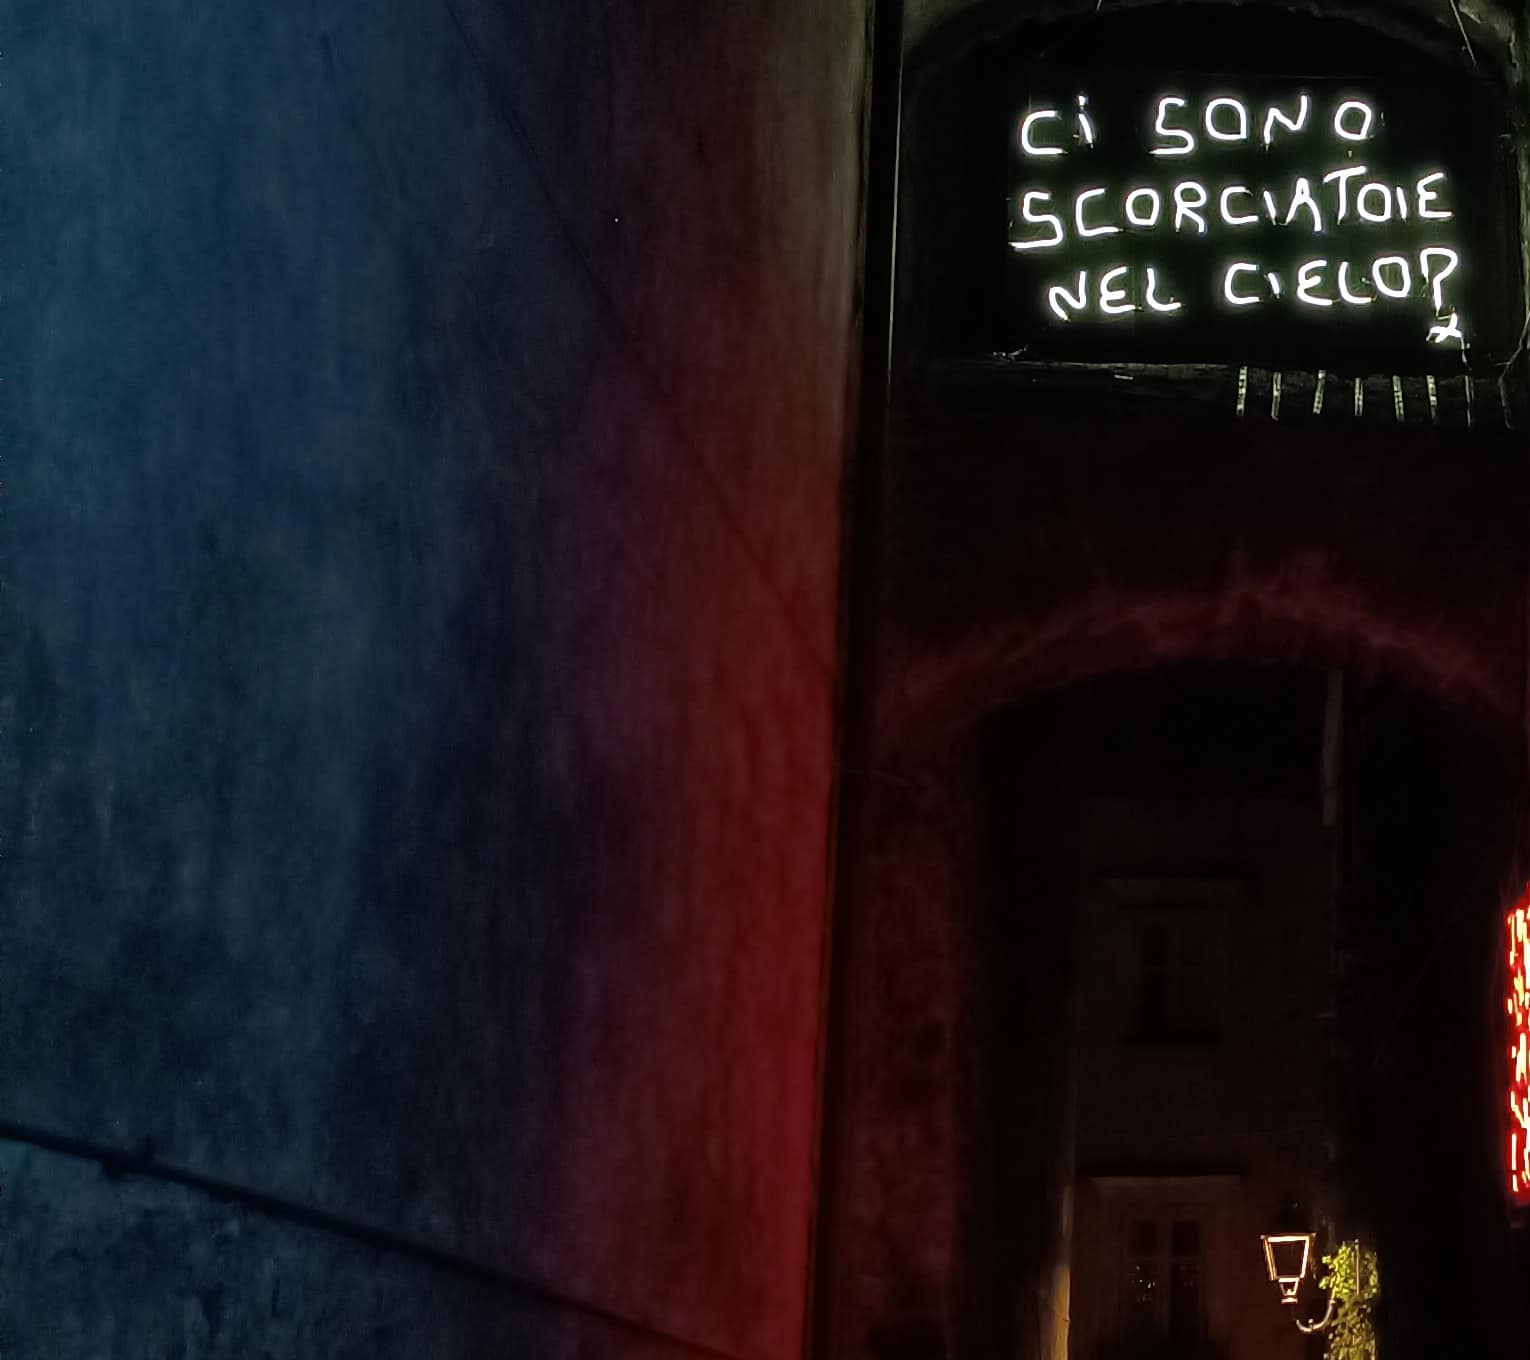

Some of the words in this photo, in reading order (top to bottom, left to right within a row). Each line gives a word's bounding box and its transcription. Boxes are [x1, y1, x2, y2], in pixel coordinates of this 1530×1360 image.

[1150, 95, 1373, 155] SONO
[1010, 165, 1453, 249] SCORCIATOIE
[1047, 265, 1183, 322] NEL
